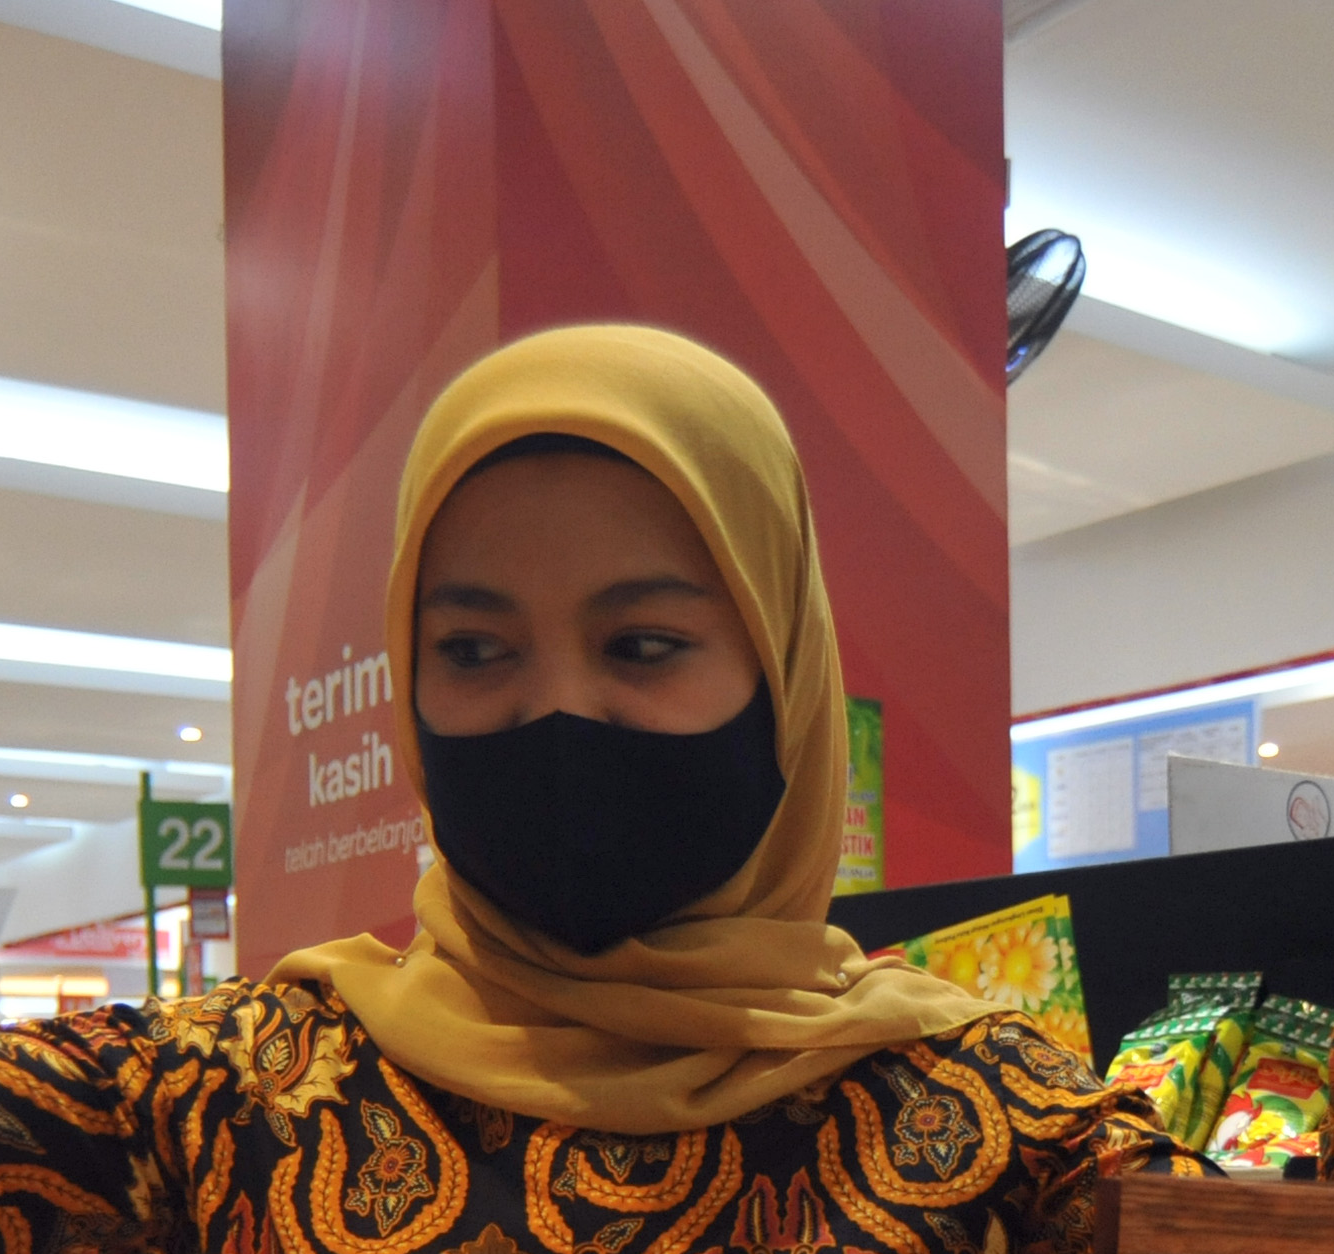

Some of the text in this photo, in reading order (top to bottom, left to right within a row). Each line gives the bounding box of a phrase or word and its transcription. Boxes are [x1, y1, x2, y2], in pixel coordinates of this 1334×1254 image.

[285, 643, 393, 736] terim
[308, 731, 393, 808] kasih
[157, 816, 225, 871] 22
